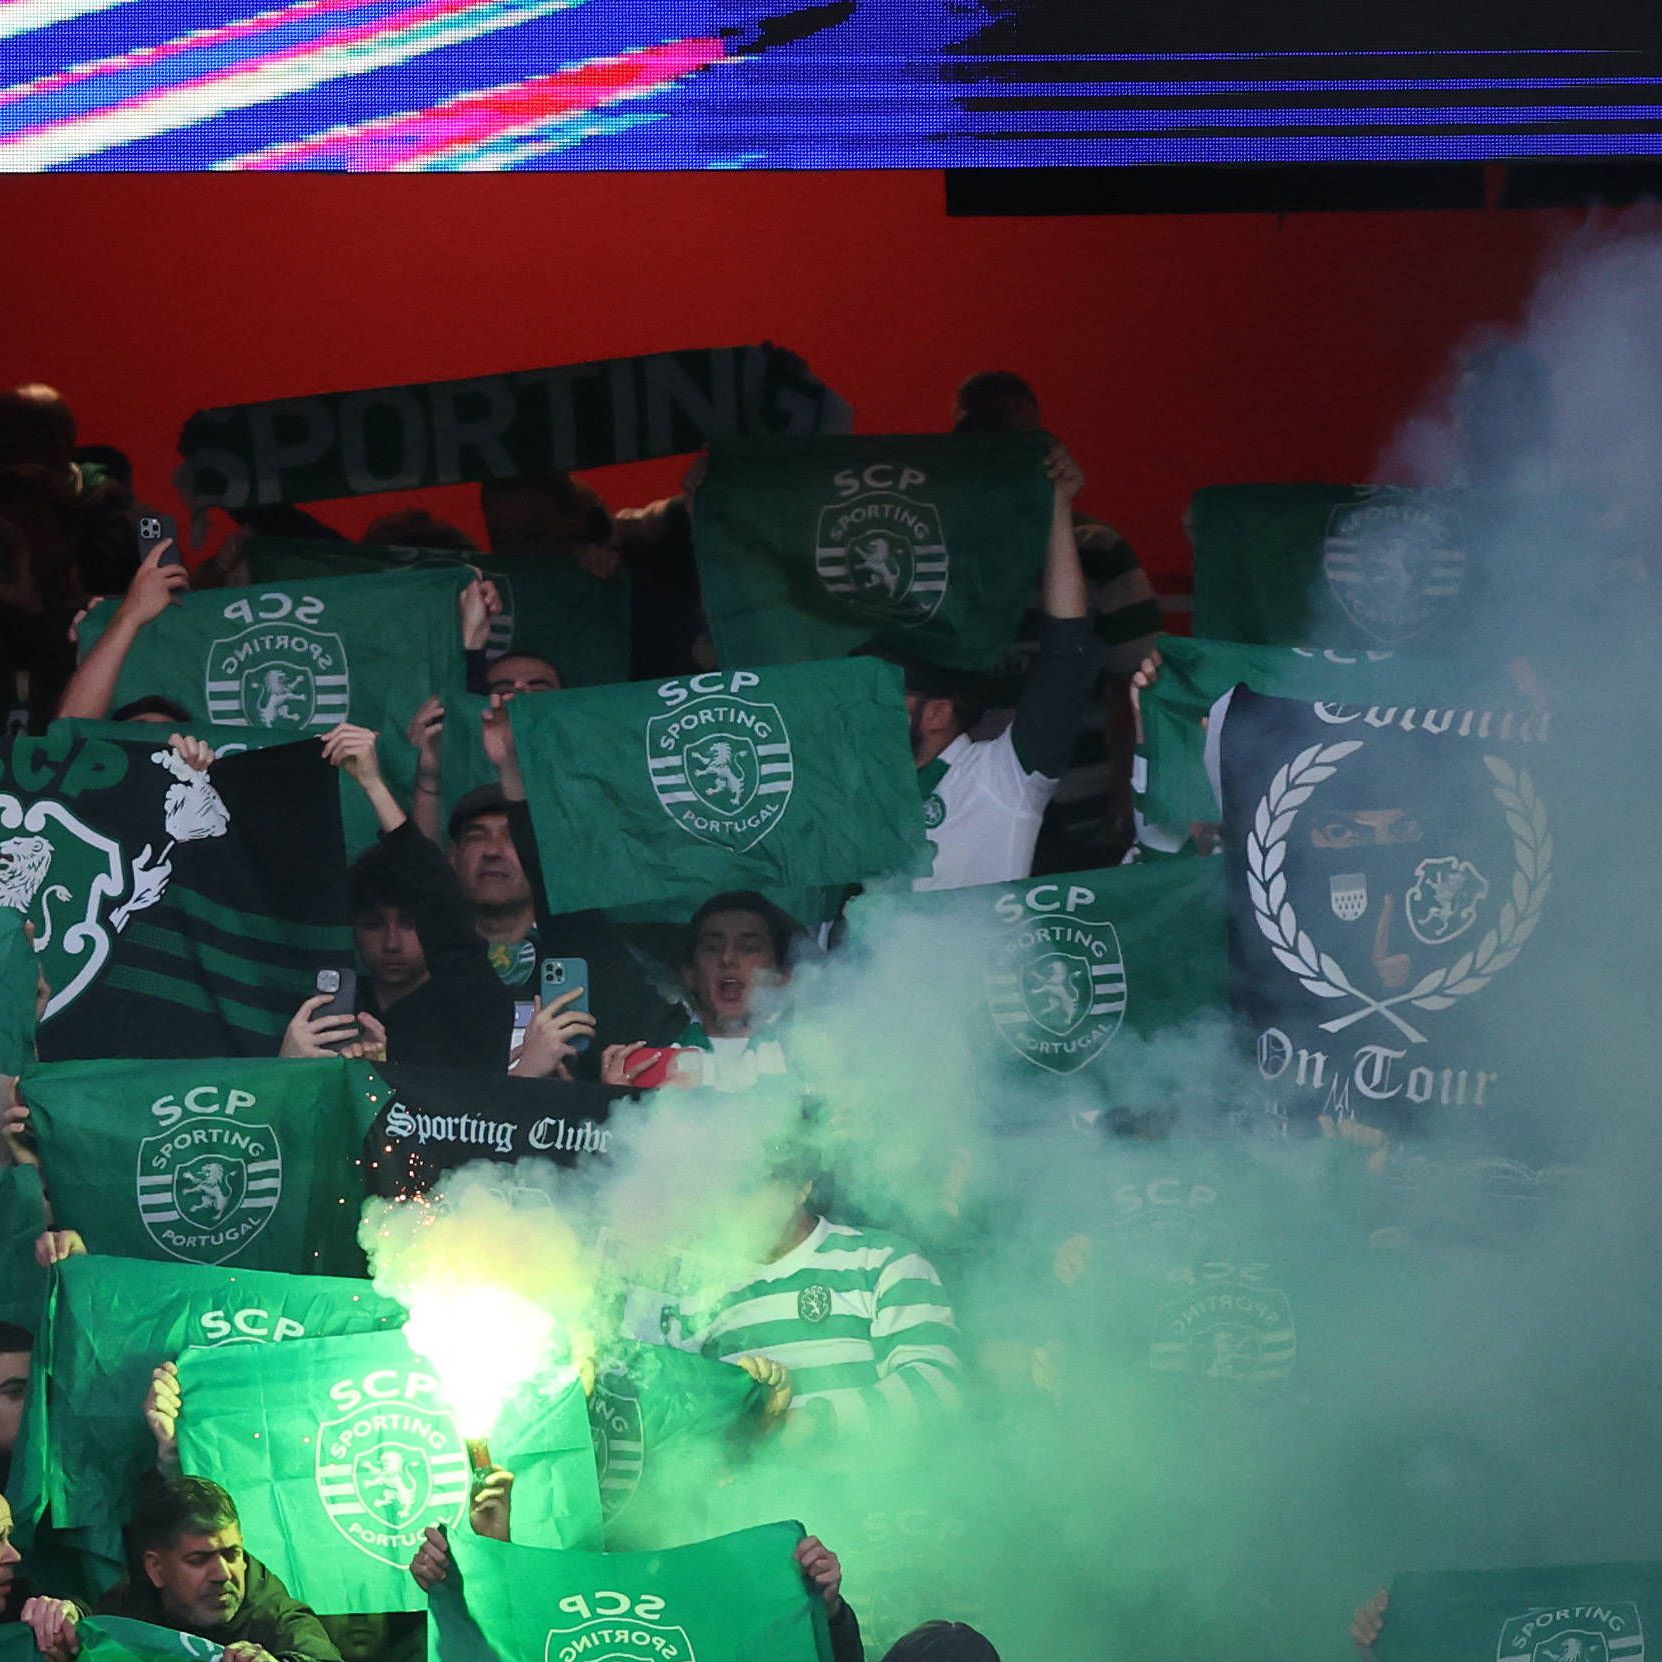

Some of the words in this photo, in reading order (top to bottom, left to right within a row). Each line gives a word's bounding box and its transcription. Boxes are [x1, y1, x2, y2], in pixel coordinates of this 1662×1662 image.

[178, 343, 840, 510] SPORTING
[833, 464, 927, 496] SCP
[828, 504, 931, 543] SPORTING
[657, 670, 761, 706] SCP
[660, 708, 773, 750] SPORTING
[683, 799, 779, 834] PORTUGAL
[995, 884, 1098, 924] SCP
[993, 926, 1108, 961] SPORTING
[1014, 1020, 1111, 1056] PORTUGAL
[1257, 1028, 1326, 1091] On
[1353, 1044, 1498, 1106] Tour
[151, 1086, 257, 1125] SCP
[386, 1102, 517, 1151] Sporting
[528, 1108, 614, 1155] Clube
[151, 1128, 266, 1170] SPORTING
[162, 1212, 262, 1248] PORTUGAL
[201, 1308, 306, 1344] SCP
[329, 1414, 448, 1461] SPORTING
[1511, 1605, 1626, 1650] SPORTING
